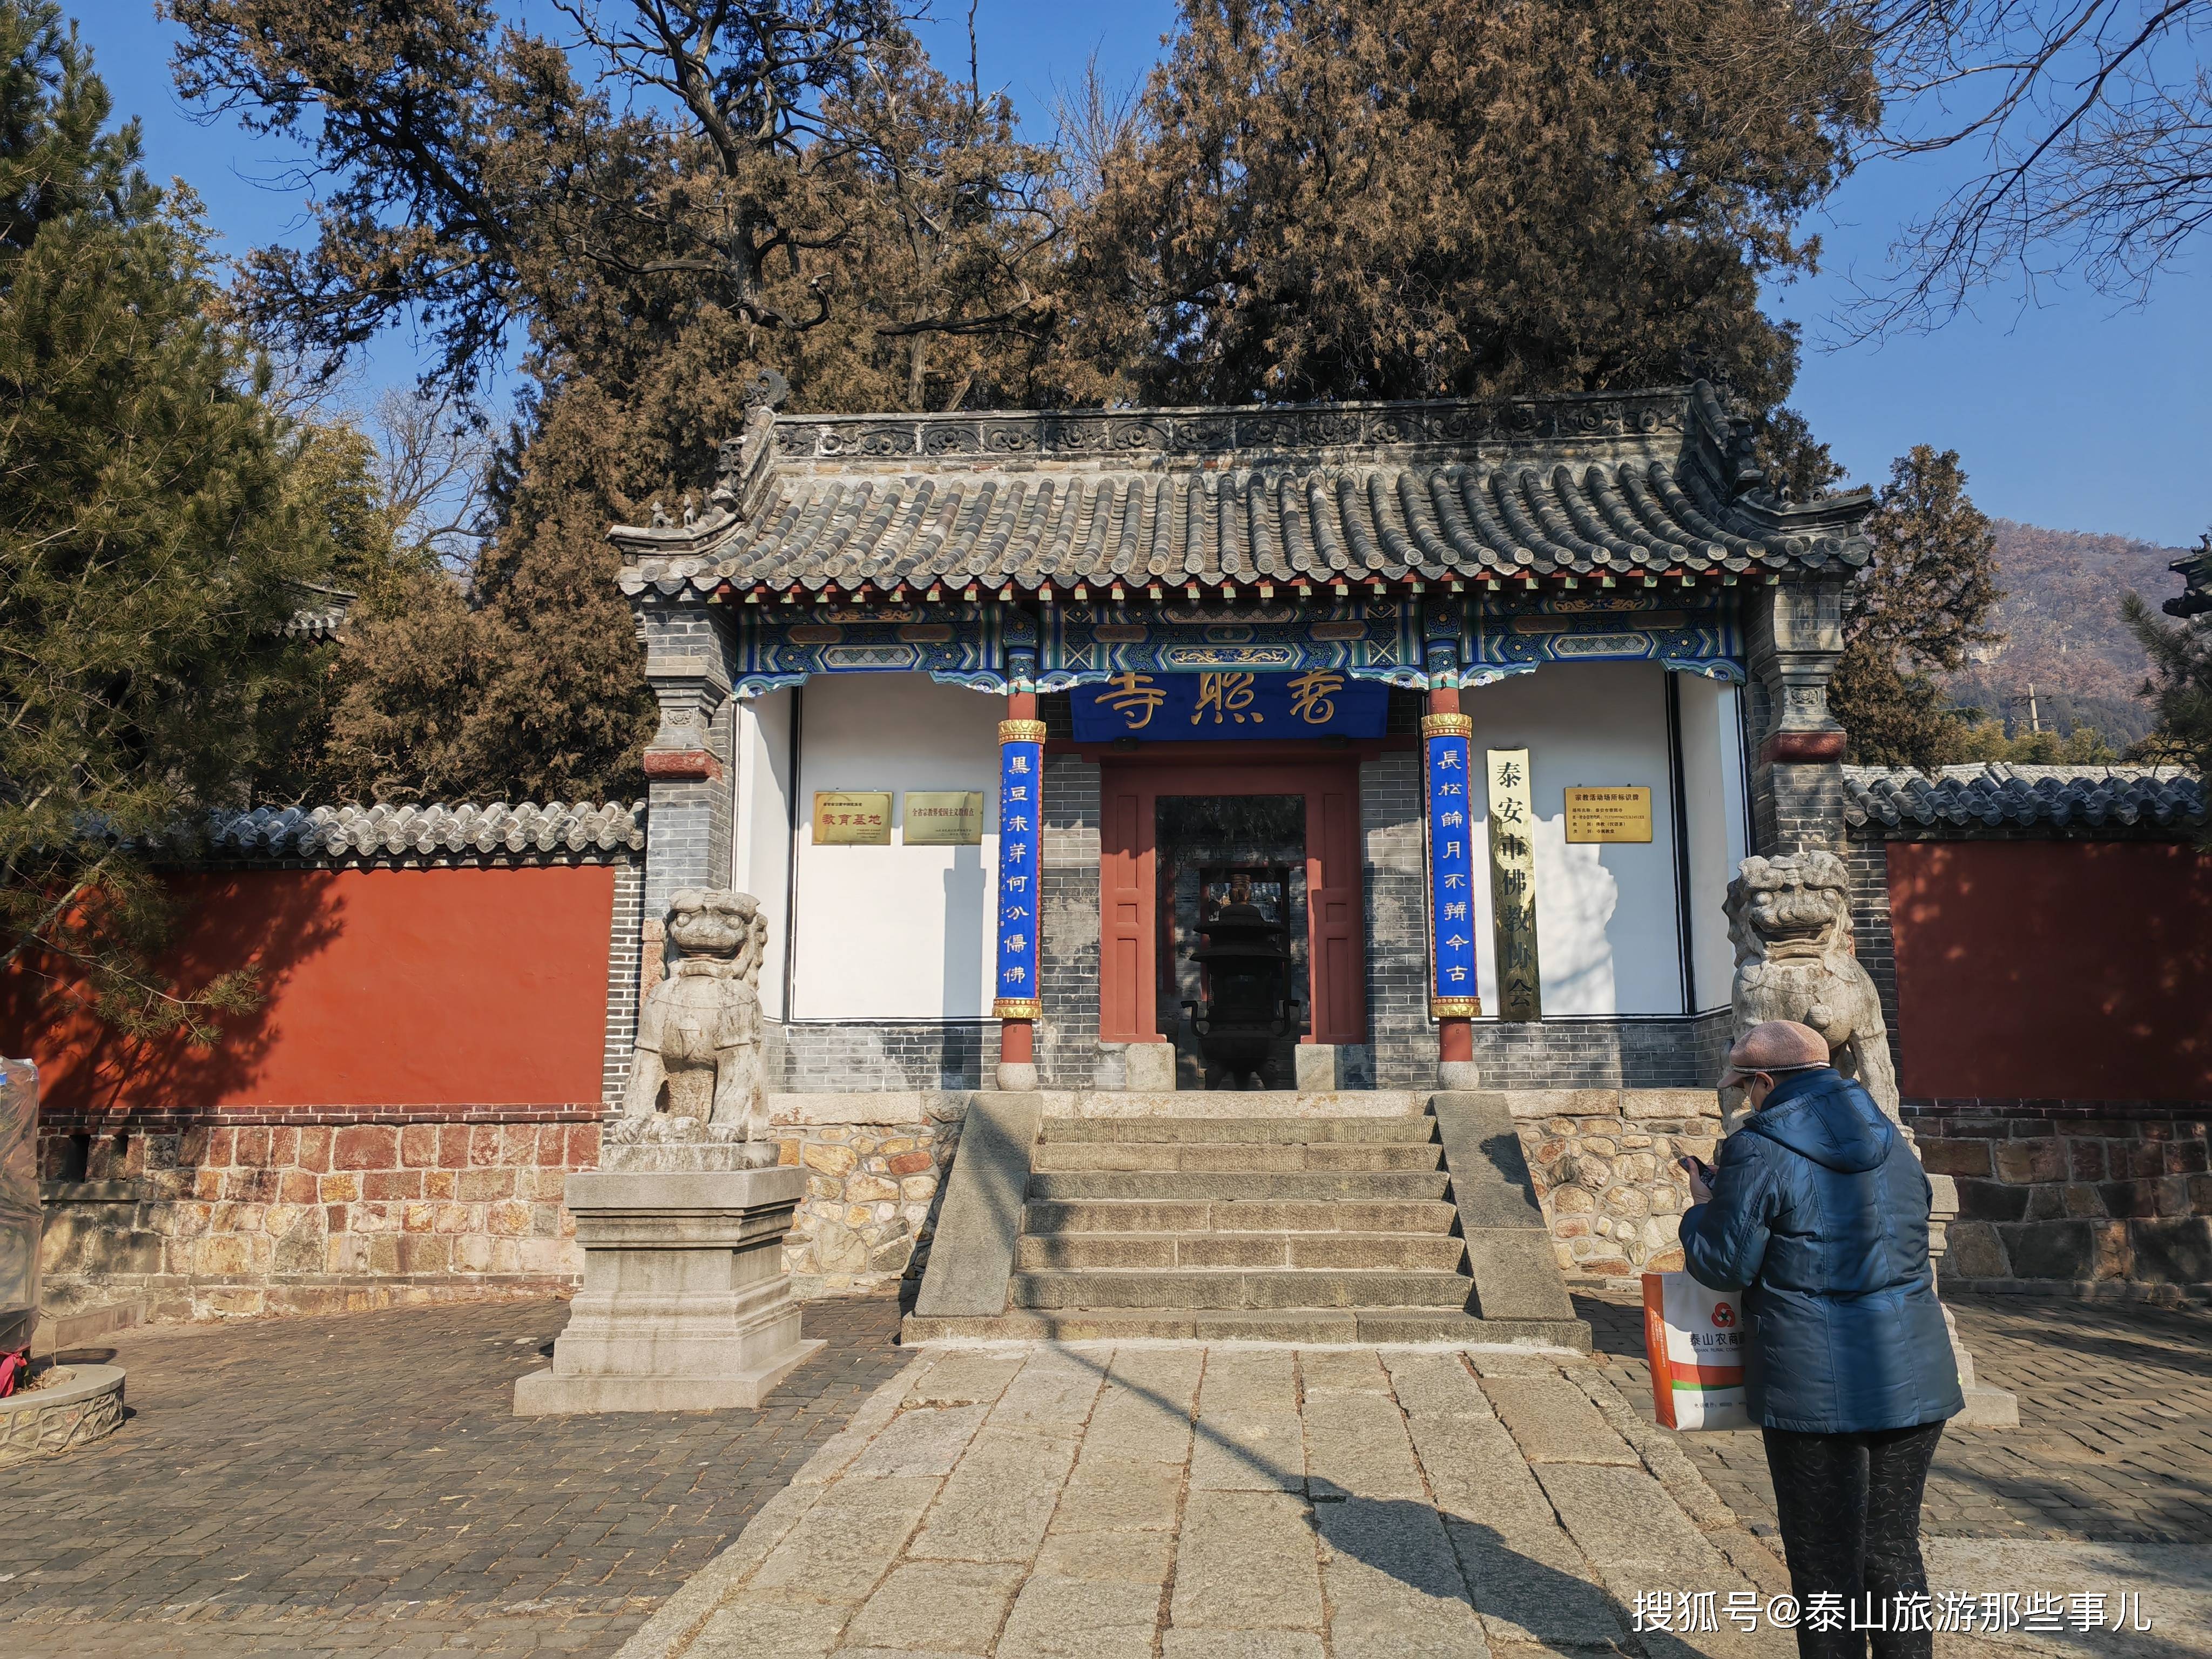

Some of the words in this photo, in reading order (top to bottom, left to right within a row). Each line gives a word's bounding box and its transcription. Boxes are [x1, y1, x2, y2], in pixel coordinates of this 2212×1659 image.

[822, 814, 882, 826] 教育基地
[1496, 761, 1532, 1007] 泰安市佛教协会
